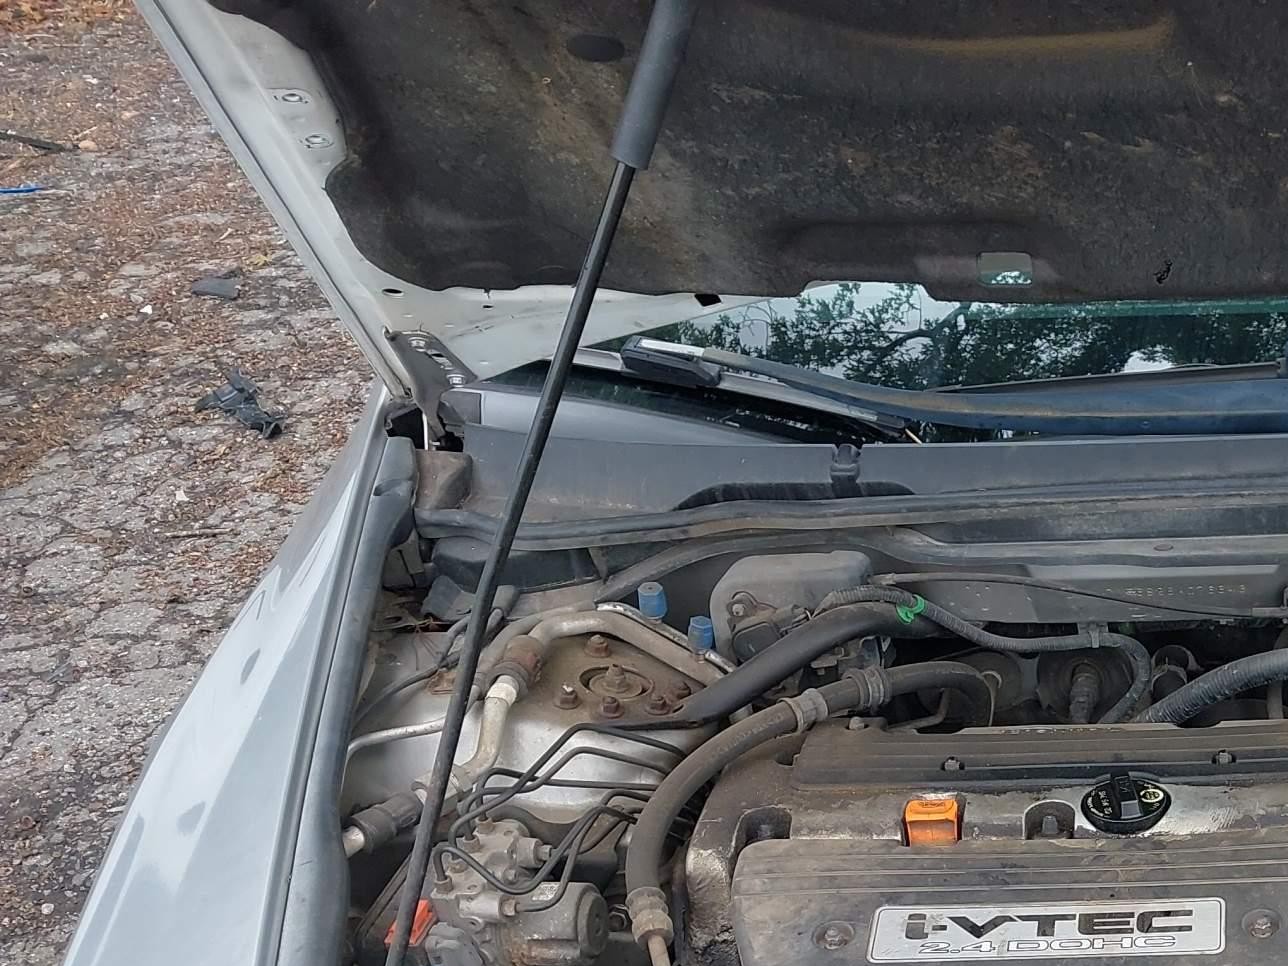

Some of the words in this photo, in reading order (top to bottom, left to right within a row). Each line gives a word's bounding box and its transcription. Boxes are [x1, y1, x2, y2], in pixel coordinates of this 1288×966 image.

[905, 909, 1194, 941] i-VTEC
[918, 940, 996, 954] 2.4
[1006, 935, 1177, 953] DOHC
